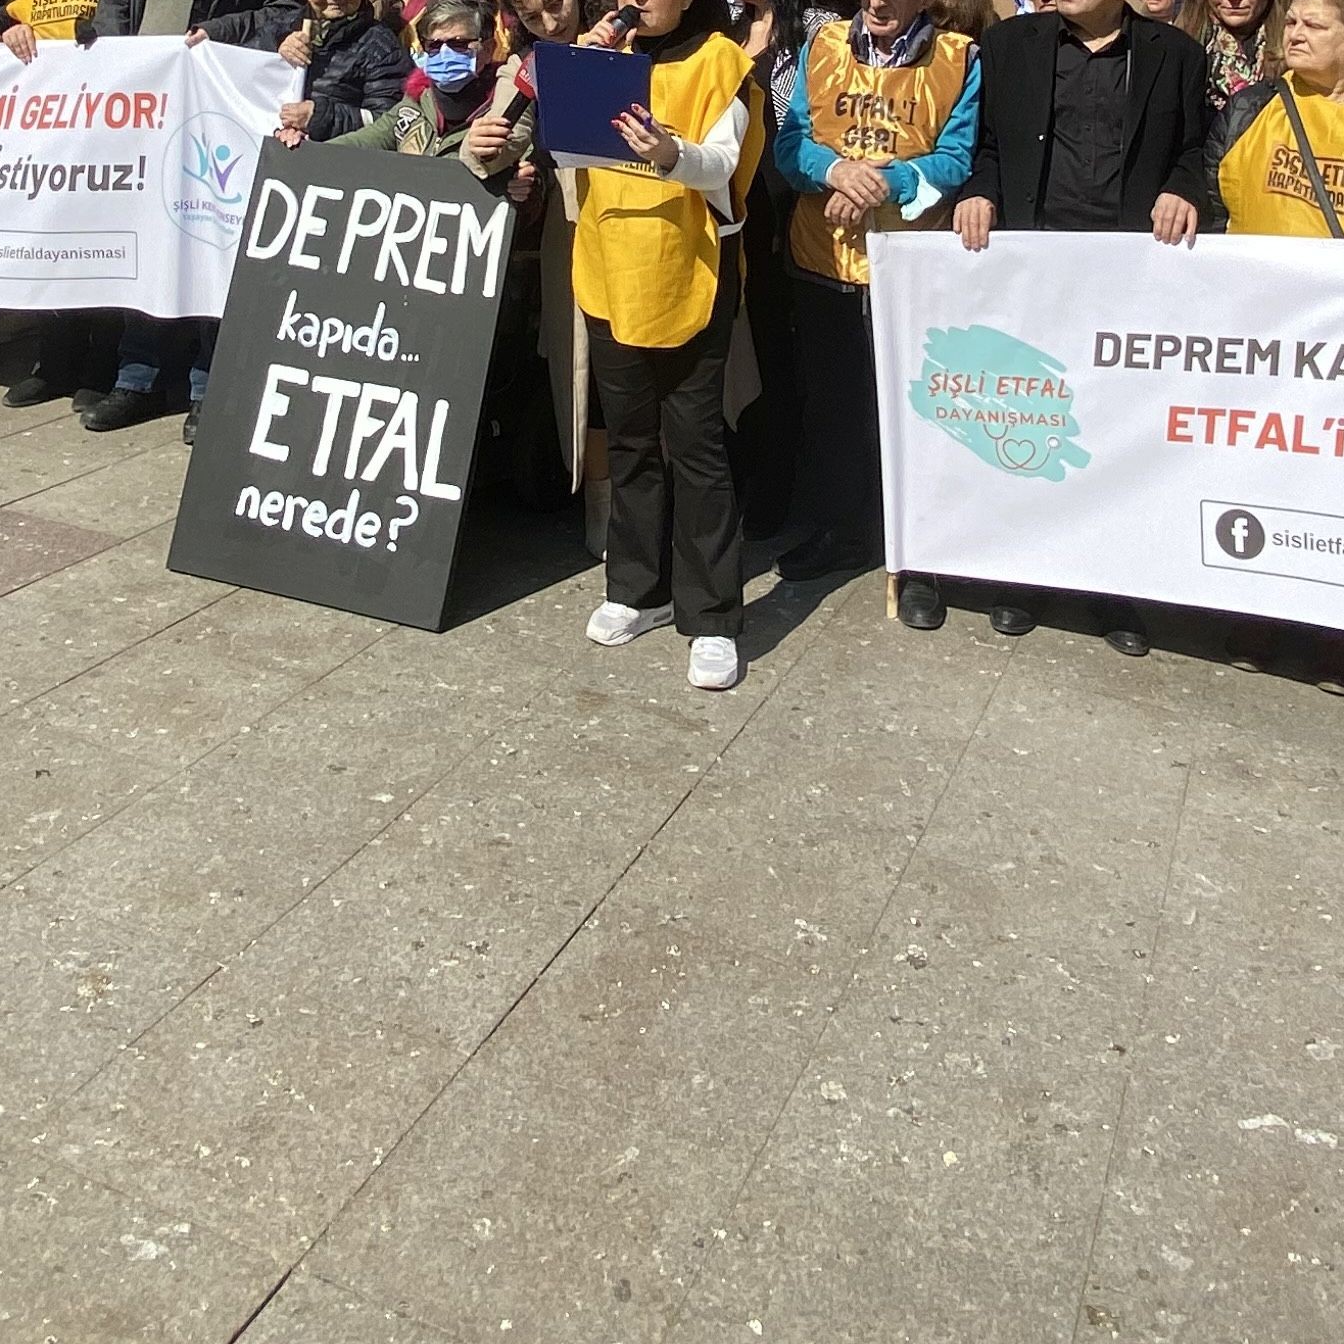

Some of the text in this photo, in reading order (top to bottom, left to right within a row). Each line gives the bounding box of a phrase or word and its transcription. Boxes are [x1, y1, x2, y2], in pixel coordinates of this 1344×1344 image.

[20, 82, 168, 130] GELİYOR!
[246, 178, 509, 297] DEPREM
[1093, 331, 1281, 377] DEPREM
[928, 369, 1071, 399] ŞİŞLİ ETFAL
[249, 363, 461, 501] ETFAL
[935, 406, 1068, 428] DAYANIŞMASI
[235, 485, 419, 552] nerede?
